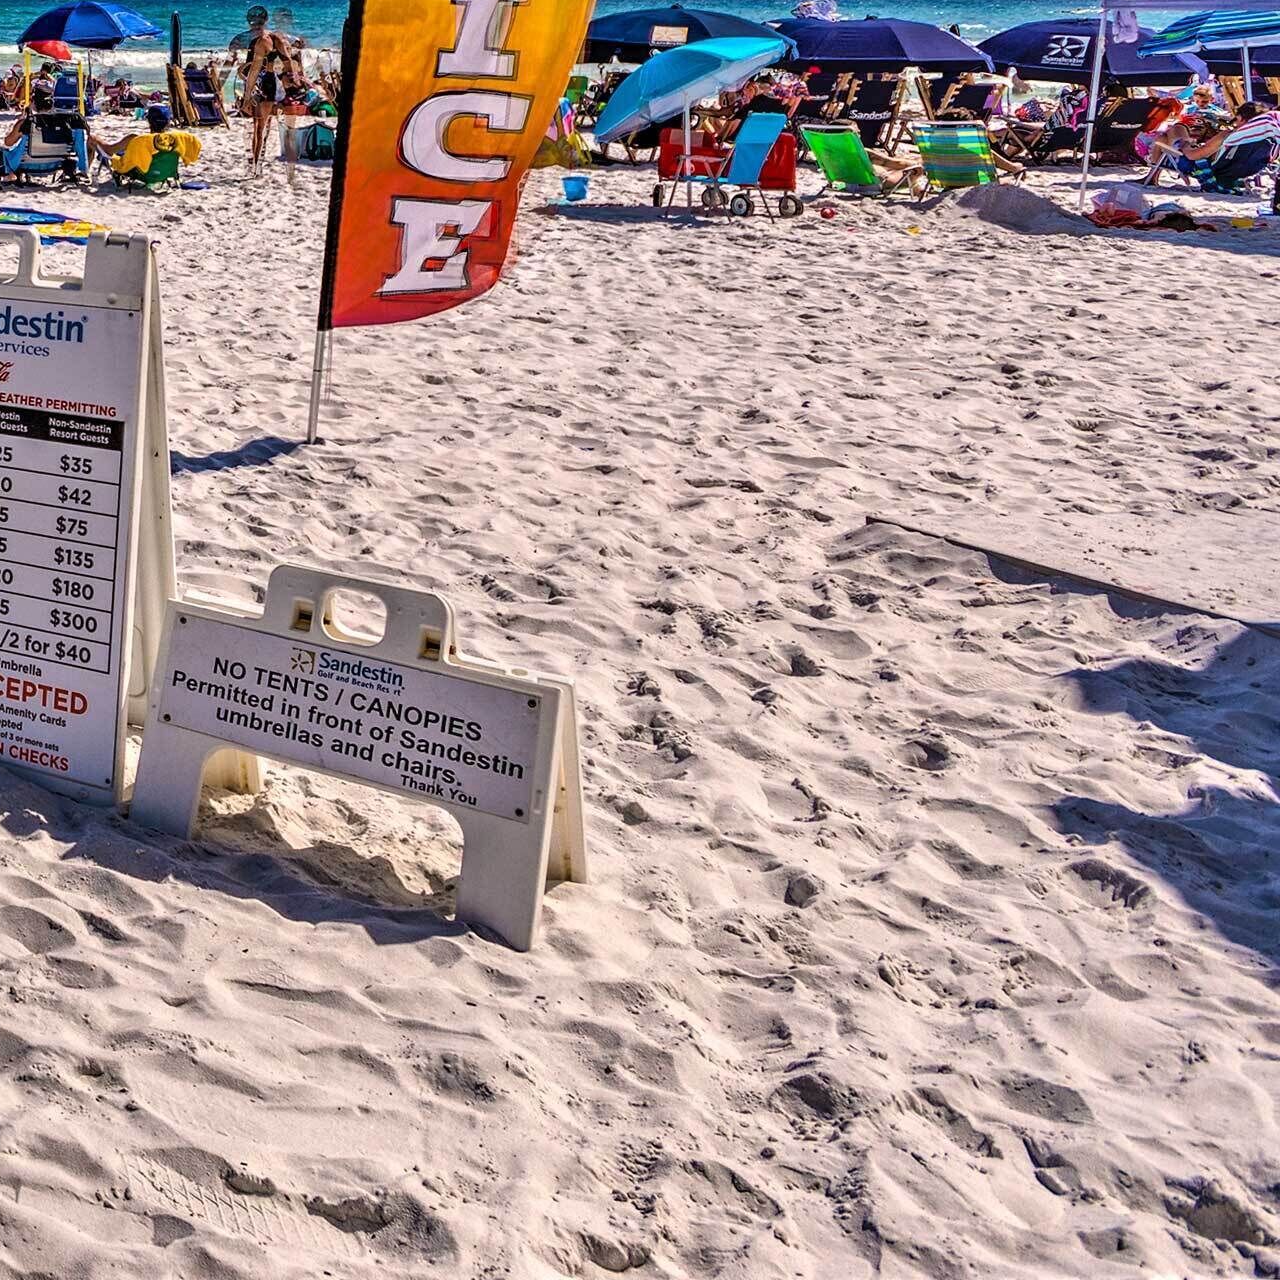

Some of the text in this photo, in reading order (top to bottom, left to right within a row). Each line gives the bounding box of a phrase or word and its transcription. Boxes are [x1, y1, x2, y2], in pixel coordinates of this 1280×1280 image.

[46, 398, 117, 417] PERMITTING
[0, 421, 28, 433] Guests
[48, 417, 112, 434] Non-Sandestin
[49, 428, 110, 444] Resort Guests
[60, 454, 92, 475] $35
[58, 484, 92, 506] $42
[56, 515, 88, 536] $75
[54, 546, 94, 569] $135
[52, 577, 94, 601] $180
[50, 608, 98, 633] $300
[24, 635, 50, 655] for
[55, 640, 91, 664] $40
[319, 652, 403, 687] Sandestin
[317, 669, 401, 696] Golf and Beach Resrt
[213, 656, 482, 741] NO TENTS / CANOPIES
[39, 713, 67, 728] Cards
[172, 669, 524, 780] Permitted in front of Sandestin
[0, 730, 9, 739] of
[8, 733, 14, 741] 3
[24, 738, 43, 747] more
[44, 743, 59, 752] sets
[216, 706, 462, 787] umbrellas and chairs.
[8, 744, 69, 772] CHECKS
[400, 774, 477, 806] Thank You
